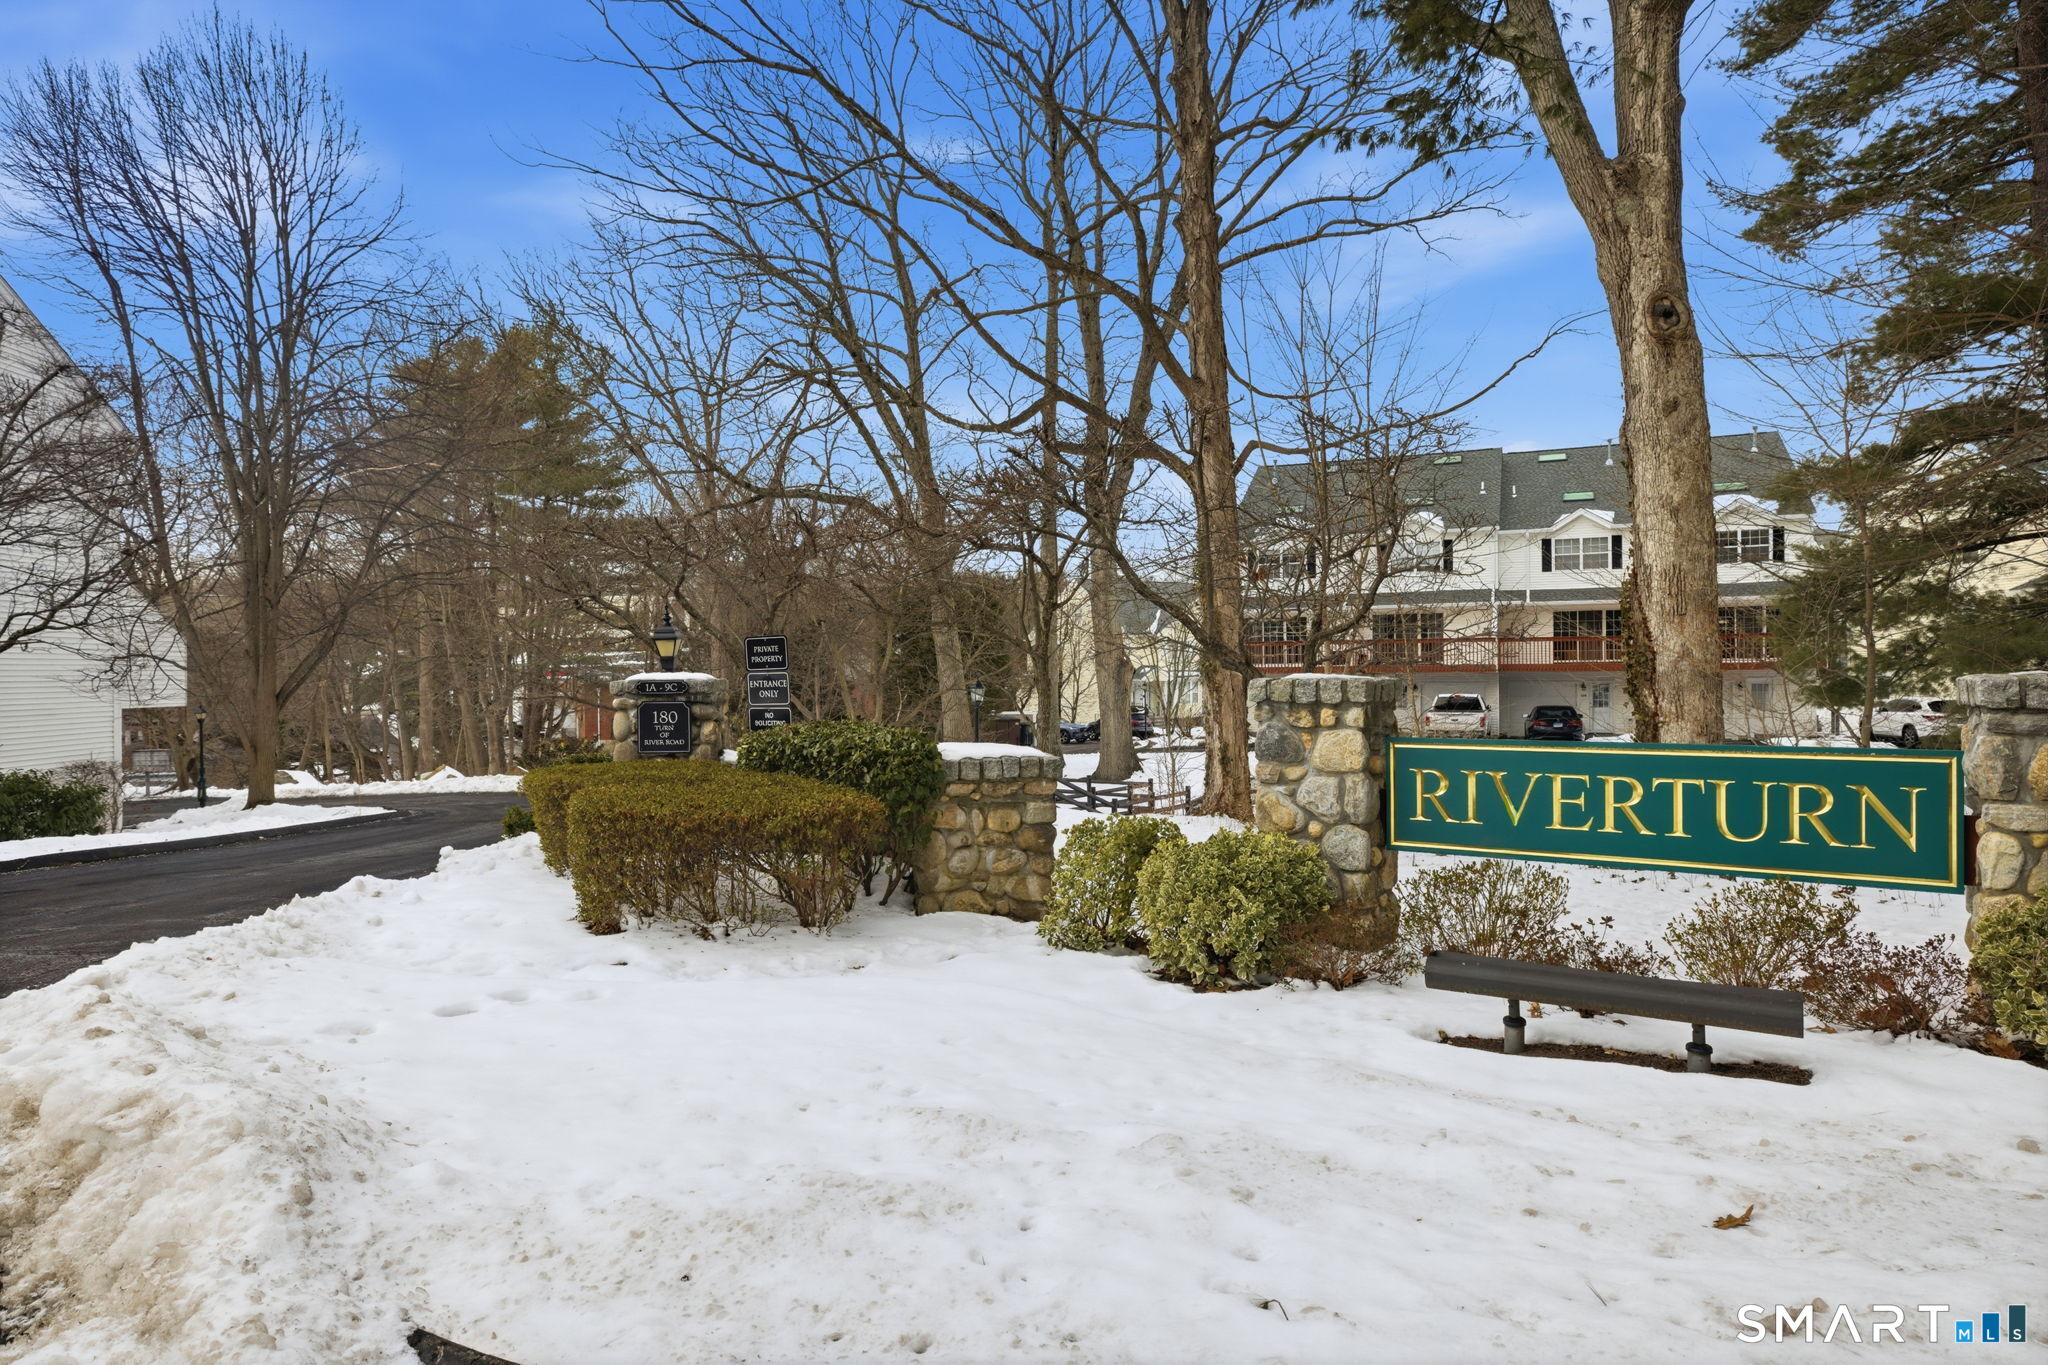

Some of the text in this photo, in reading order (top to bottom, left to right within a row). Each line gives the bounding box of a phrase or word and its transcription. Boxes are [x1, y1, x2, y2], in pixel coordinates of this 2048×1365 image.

[753, 645, 779, 653] PRIVATE
[751, 655, 783, 663] PROPERTY
[645, 683, 657, 692] 1A
[664, 683, 678, 692] 9C
[749, 680, 787, 688] ENTRANCE
[759, 690, 779, 698] ONLY
[652, 710, 678, 724] 180
[1409, 768, 1927, 853] RIVERTURN
